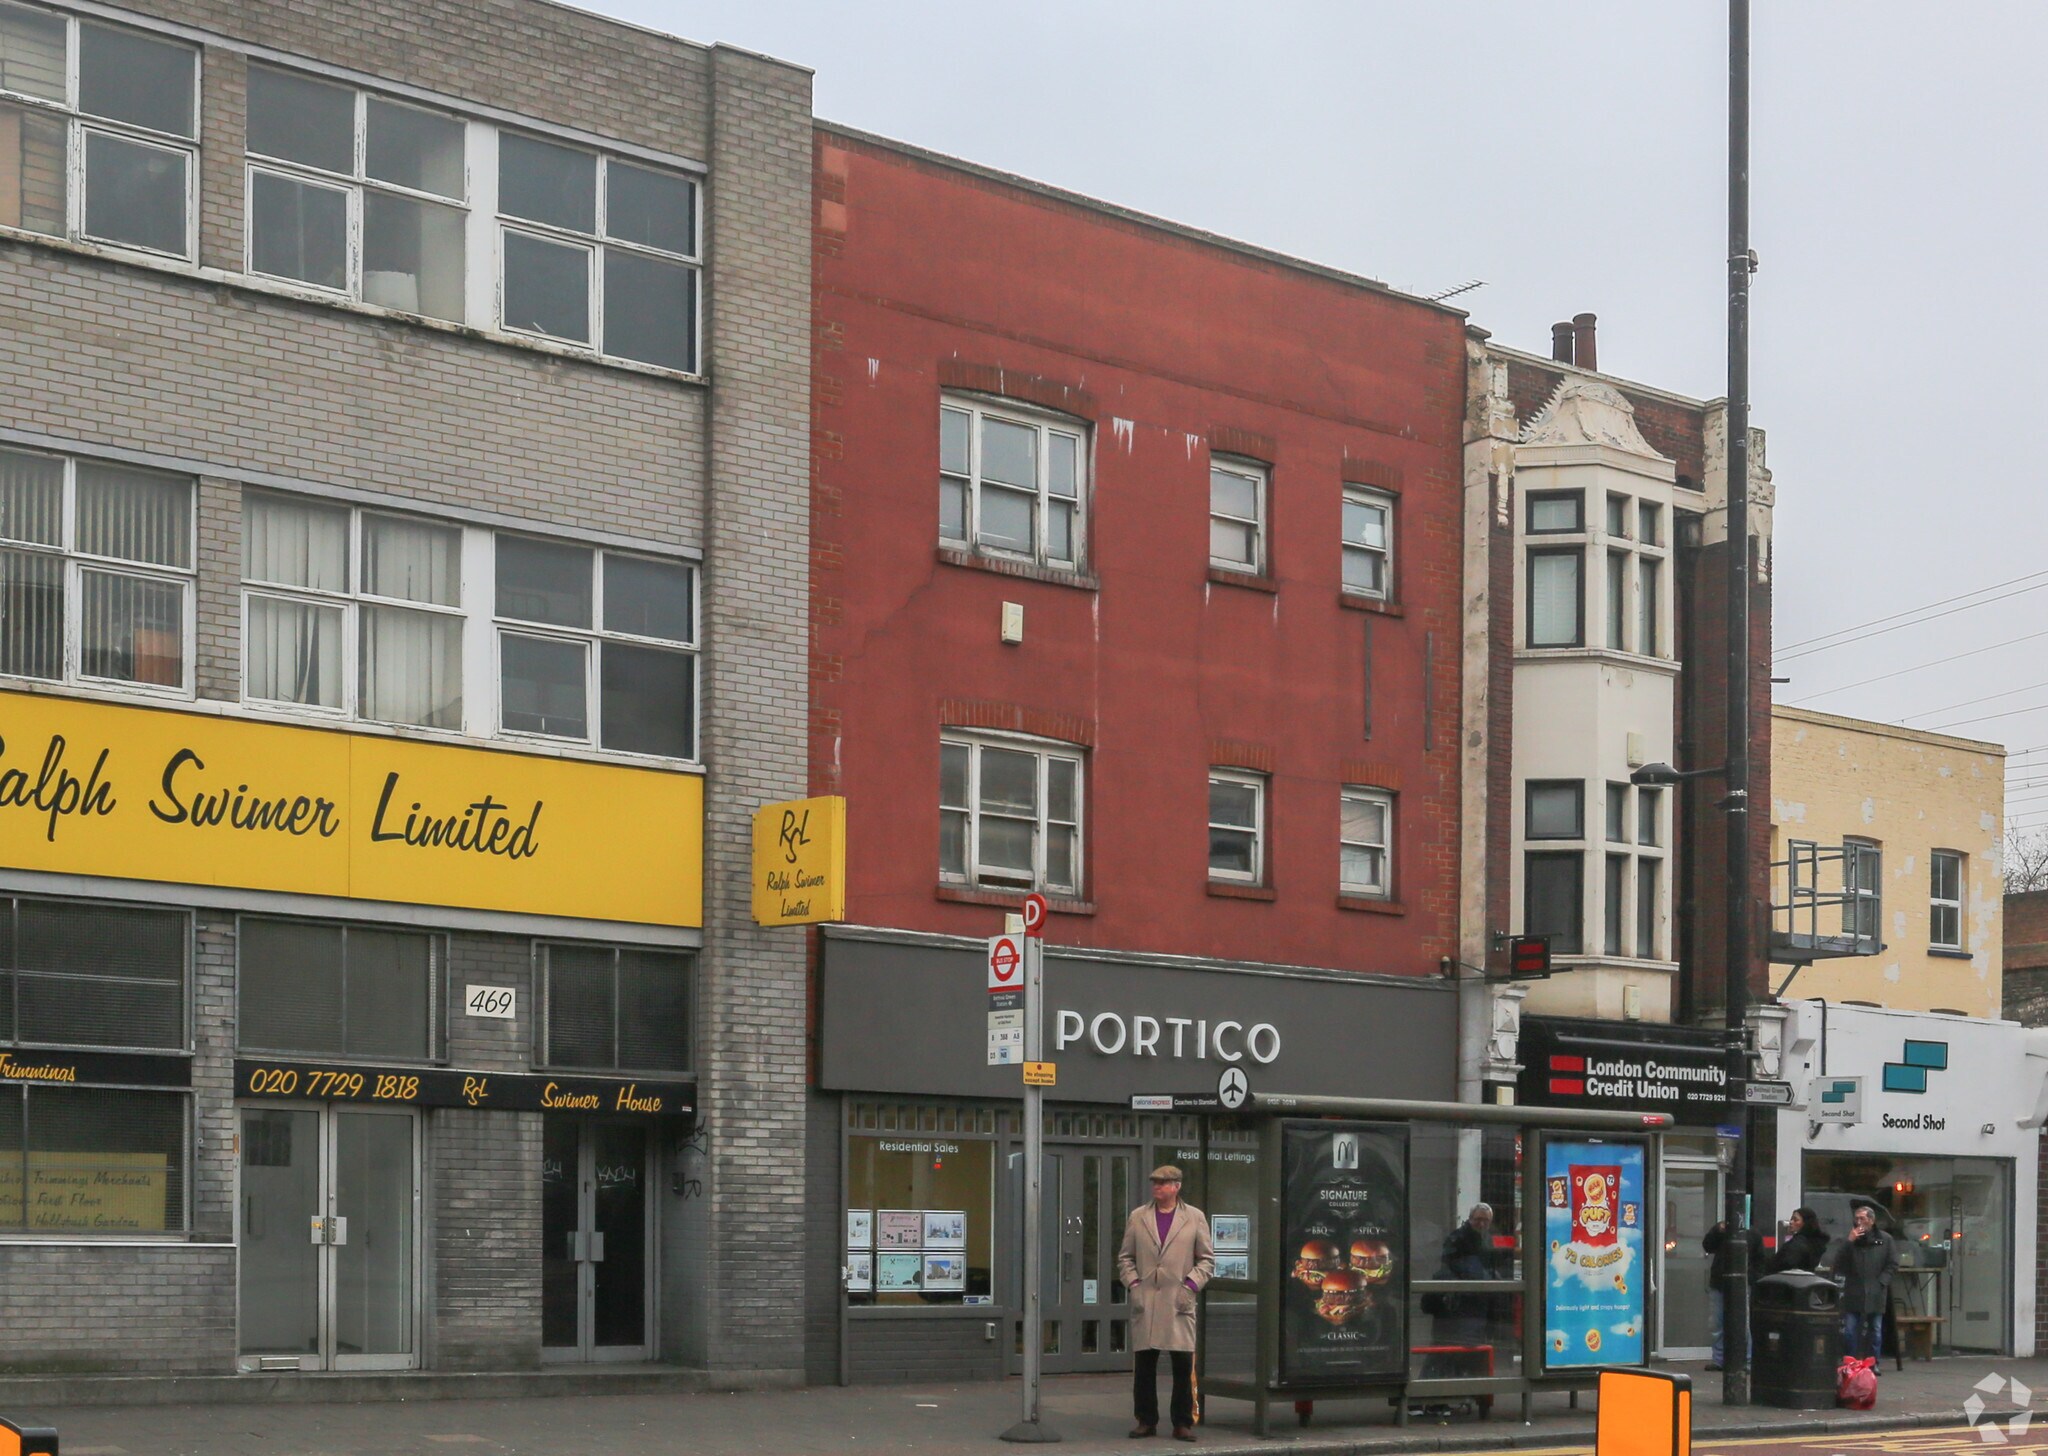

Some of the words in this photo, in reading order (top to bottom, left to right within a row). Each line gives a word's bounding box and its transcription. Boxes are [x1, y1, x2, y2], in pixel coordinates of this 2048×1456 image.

[0, 734, 116, 842] alph
[148, 748, 340, 838] Swimer
[371, 771, 543, 860] Limited
[767, 871, 790, 896] Ralph
[794, 869, 824, 889] Swimer
[781, 898, 811, 917] Limited
[1026, 900, 1040, 926] D
[996, 956, 1004, 964] BUS
[469, 990, 512, 1014] 469
[1056, 1010, 1281, 1063] PORTICO
[0, 1053, 76, 1082] Trimmings
[1586, 1057, 1642, 1078] London
[1645, 1060, 1726, 1086] Community
[250, 1069, 298, 1094] 020
[306, 1072, 364, 1096] 7729
[372, 1074, 419, 1099] 1818
[1586, 1077, 1634, 1097] Credit
[1637, 1080, 1679, 1100] Union
[541, 1082, 600, 1109] Swimer
[616, 1084, 662, 1112] House
[1687, 1093, 1698, 1101] 020
[1699, 1093, 1713, 1101] 7729
[1882, 1113, 1921, 1129] Second
[1923, 1114, 1946, 1130] Shot
[880, 1140, 932, 1152] Residential
[934, 1142, 959, 1153] Sales
[1224, 1152, 1256, 1164] Lettings
[94, 1171, 151, 1186] Merchants
[1320, 1190, 1368, 1201] SIGNATURE
[1312, 1226, 1330, 1236] BBQ
[1359, 1226, 1381, 1235] SPICY
[1565, 1248, 1578, 1264] 72
[1580, 1247, 1623, 1268] CALORIES
[1327, 1331, 1359, 1340] CLASSIC
